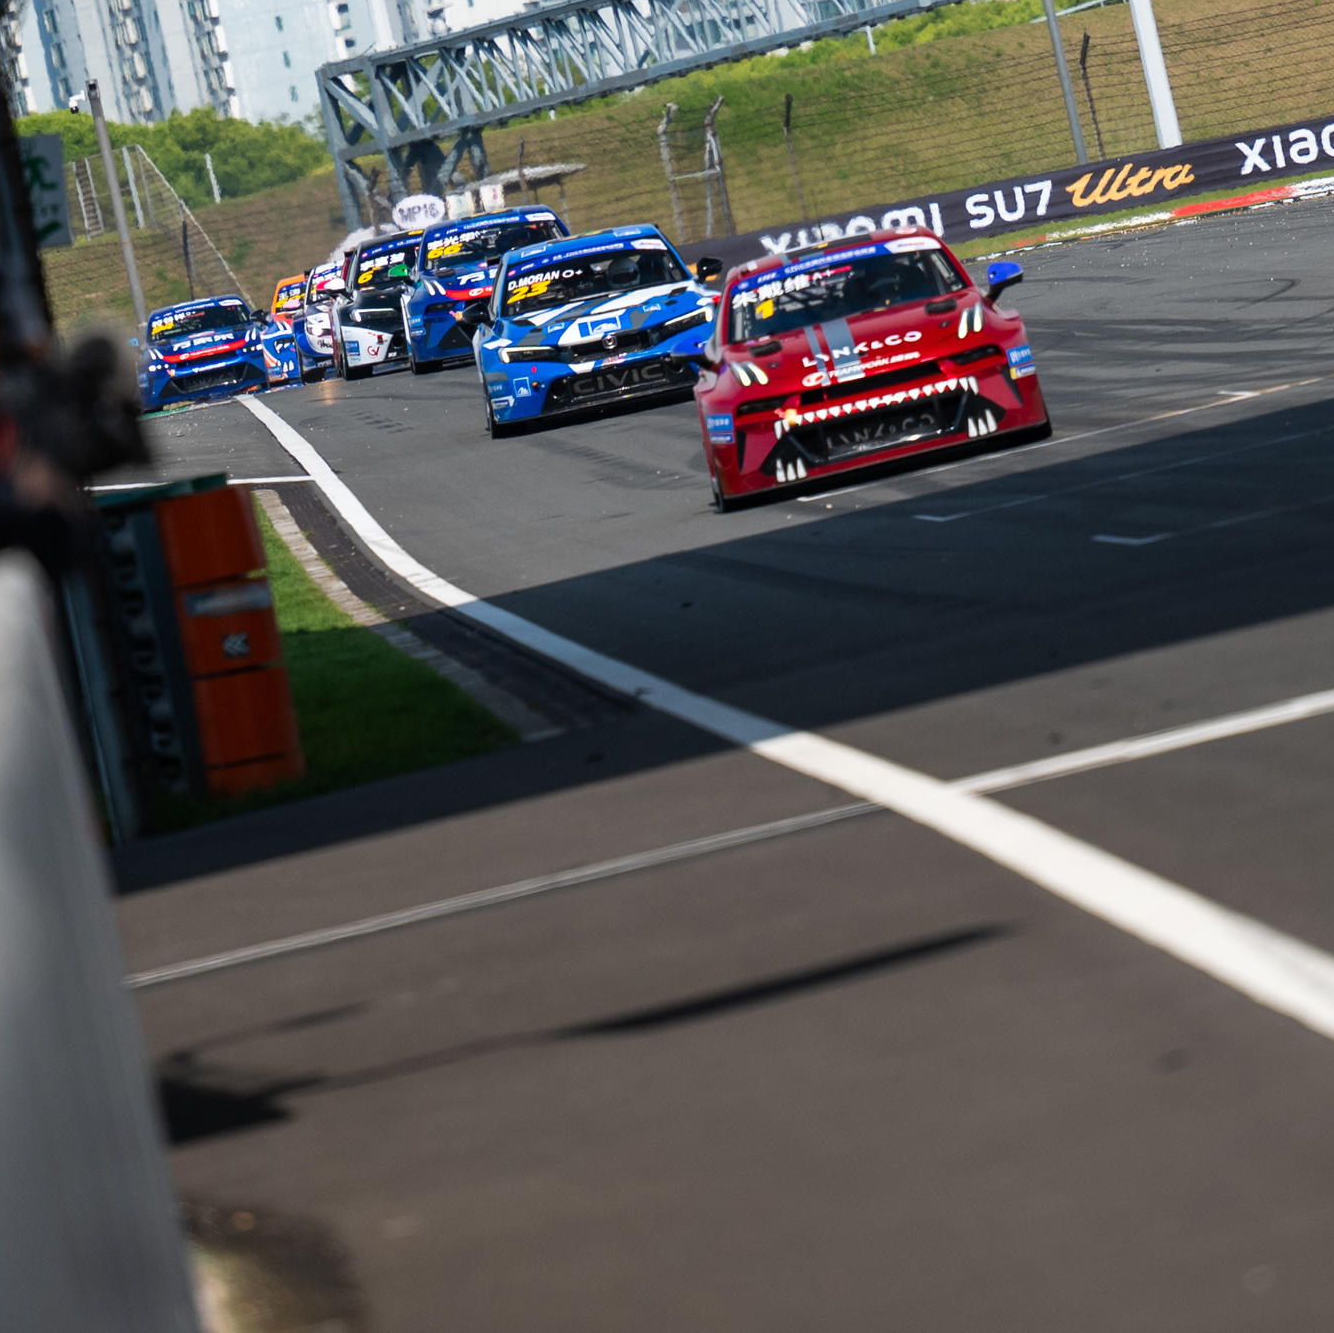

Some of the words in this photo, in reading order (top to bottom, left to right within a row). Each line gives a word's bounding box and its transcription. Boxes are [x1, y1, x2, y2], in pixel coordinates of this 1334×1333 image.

[965, 179, 1053, 229] SU7
[1065, 163, 1195, 208] Ultra
[427, 243, 463, 260] 66
[506, 279, 552, 305] 23
[507, 269, 561, 292] D.MORAN
[755, 299, 775, 320] 1
[802, 330, 923, 368] LYNK&CO
[573, 363, 665, 395] CIVIC
